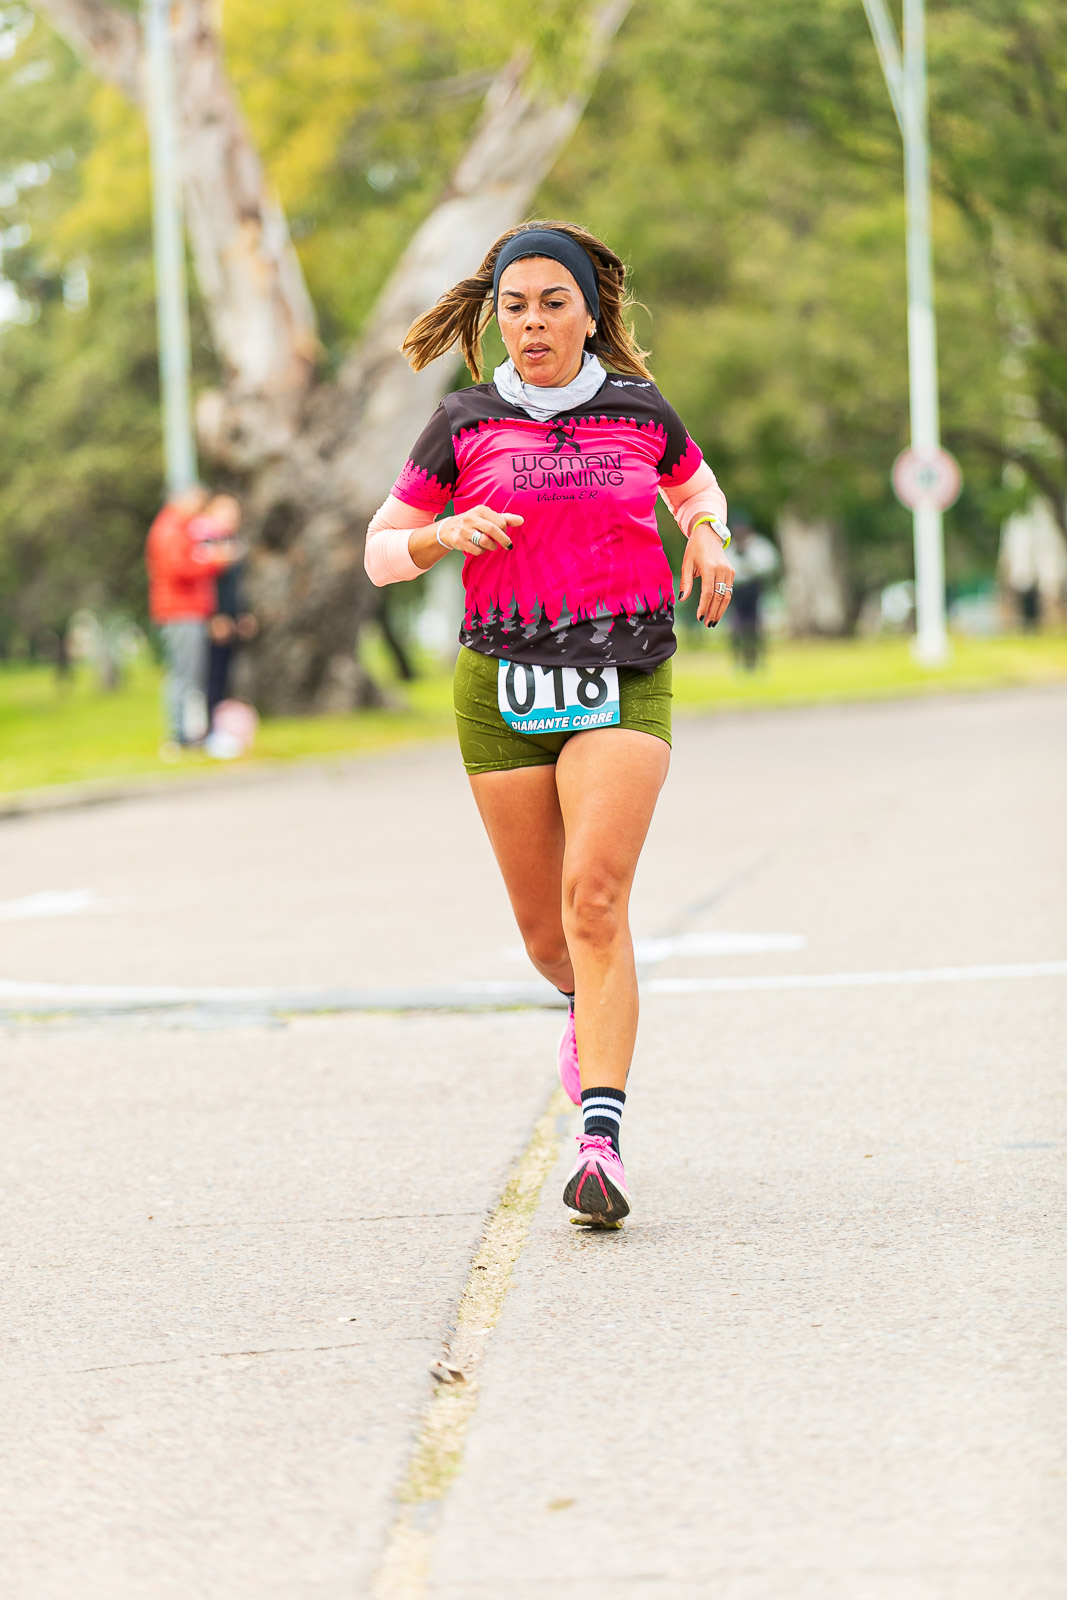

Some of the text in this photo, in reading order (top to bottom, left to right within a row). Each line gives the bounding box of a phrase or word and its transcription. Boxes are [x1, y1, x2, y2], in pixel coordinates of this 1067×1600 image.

[512, 454, 621, 473] WOMAN
[513, 470, 624, 491] RUNNING
[537, 492, 575, 502] Victoria
[506, 661, 608, 715] 018
[511, 711, 614, 731] DIAMANTE CORRE
